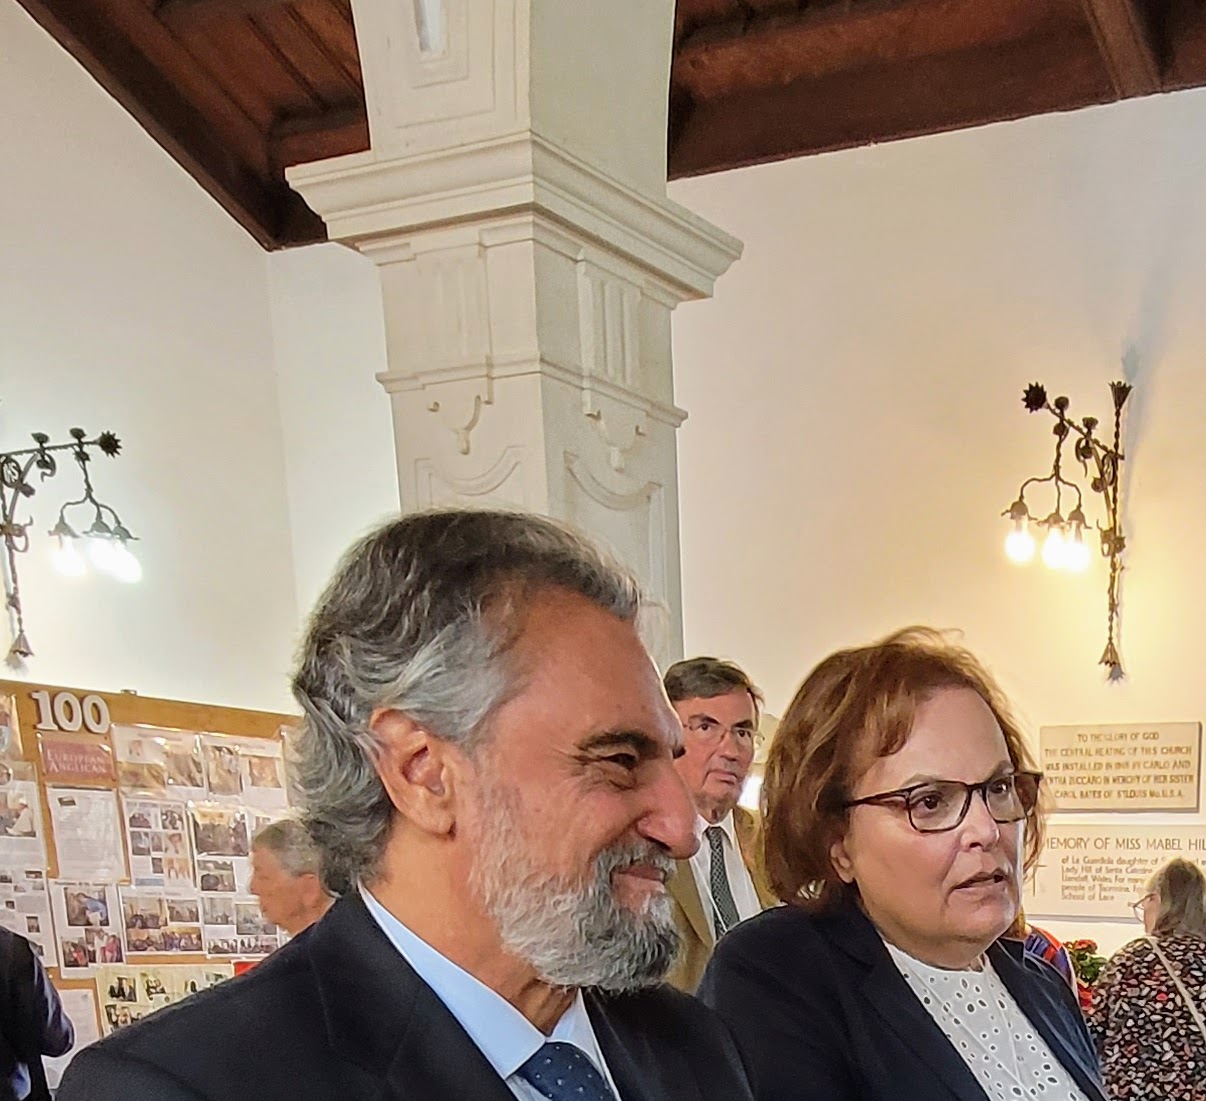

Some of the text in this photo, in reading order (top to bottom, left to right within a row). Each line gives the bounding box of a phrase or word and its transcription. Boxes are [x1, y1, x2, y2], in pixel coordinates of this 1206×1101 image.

[31, 690, 110, 734] 100
[1077, 733, 1088, 742] TO
[1130, 732, 1140, 740] OF
[1143, 732, 1159, 740] GOD
[1061, 748, 1093, 757] CENTRAL
[1095, 747, 1125, 756] HEATING
[1142, 746, 1157, 755] THIS
[1161, 746, 1192, 755] CHURCH
[48, 761, 106, 774] ANGLICAN
[1062, 762, 1103, 771] INSTALLED
[1143, 761, 1170, 769] CARLO
[1172, 760, 1191, 769] AND
[1112, 775, 1141, 785] MEMORY
[1142, 775, 1152, 784] OF
[1153, 775, 1168, 784] HER
[1169, 775, 1194, 784] SISTER
[1055, 789, 1077, 799] CAROL
[1103, 789, 1114, 798] OF
[1093, 837, 1110, 850] OF
[1115, 838, 1141, 850] MISS
[1146, 838, 1183, 850] MABEL
